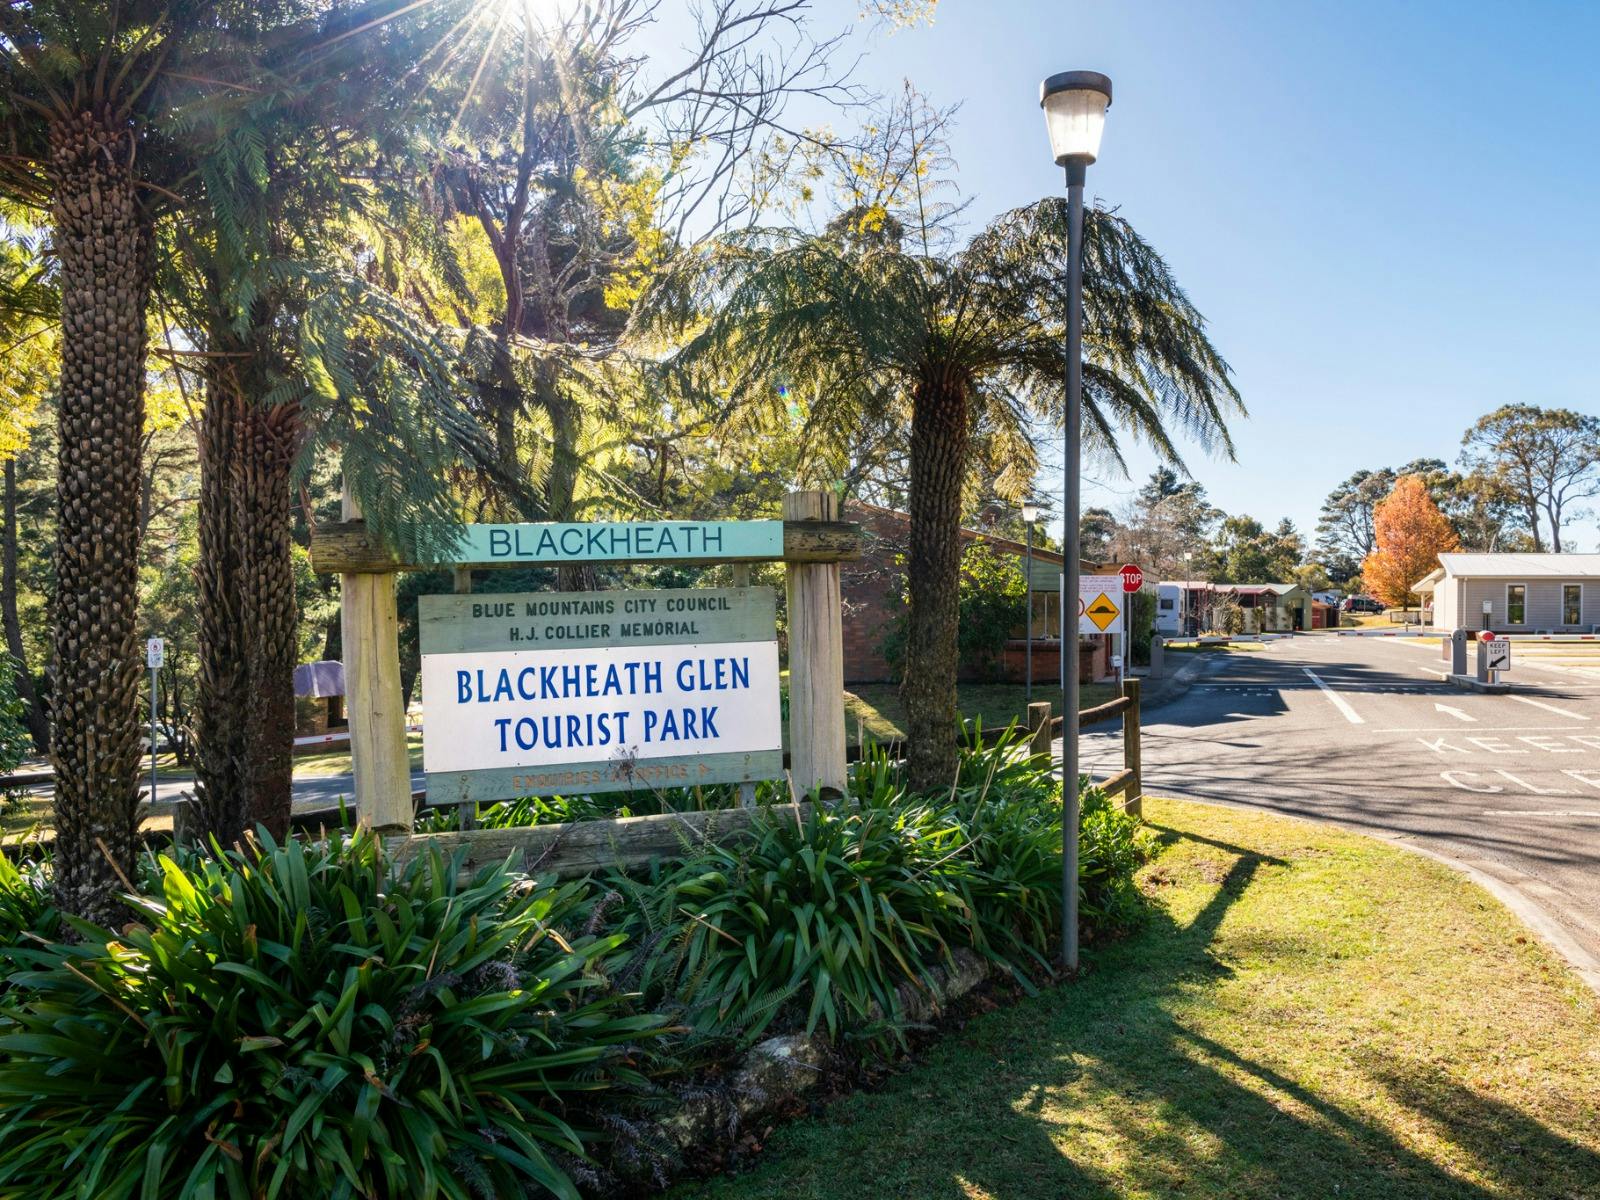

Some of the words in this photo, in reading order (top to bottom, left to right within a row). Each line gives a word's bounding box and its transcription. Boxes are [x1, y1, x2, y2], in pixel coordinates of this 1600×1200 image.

[489, 526, 722, 557] BLACKHEATH
[472, 602, 516, 618] BLUE
[525, 600, 615, 617] MOUNTAINS
[624, 599, 657, 614] CITY
[666, 597, 731, 612] COUNCIL
[510, 626, 539, 641] H.J.
[545, 623, 610, 640] COLLIER
[620, 621, 699, 637] MEMORIAL
[456, 661, 662, 704] BLACKHEATH
[676, 657, 750, 691] GLEN
[494, 711, 630, 752] TOURIST
[643, 706, 720, 742] PARK
[512, 769, 600, 792] ENQUIRIES
